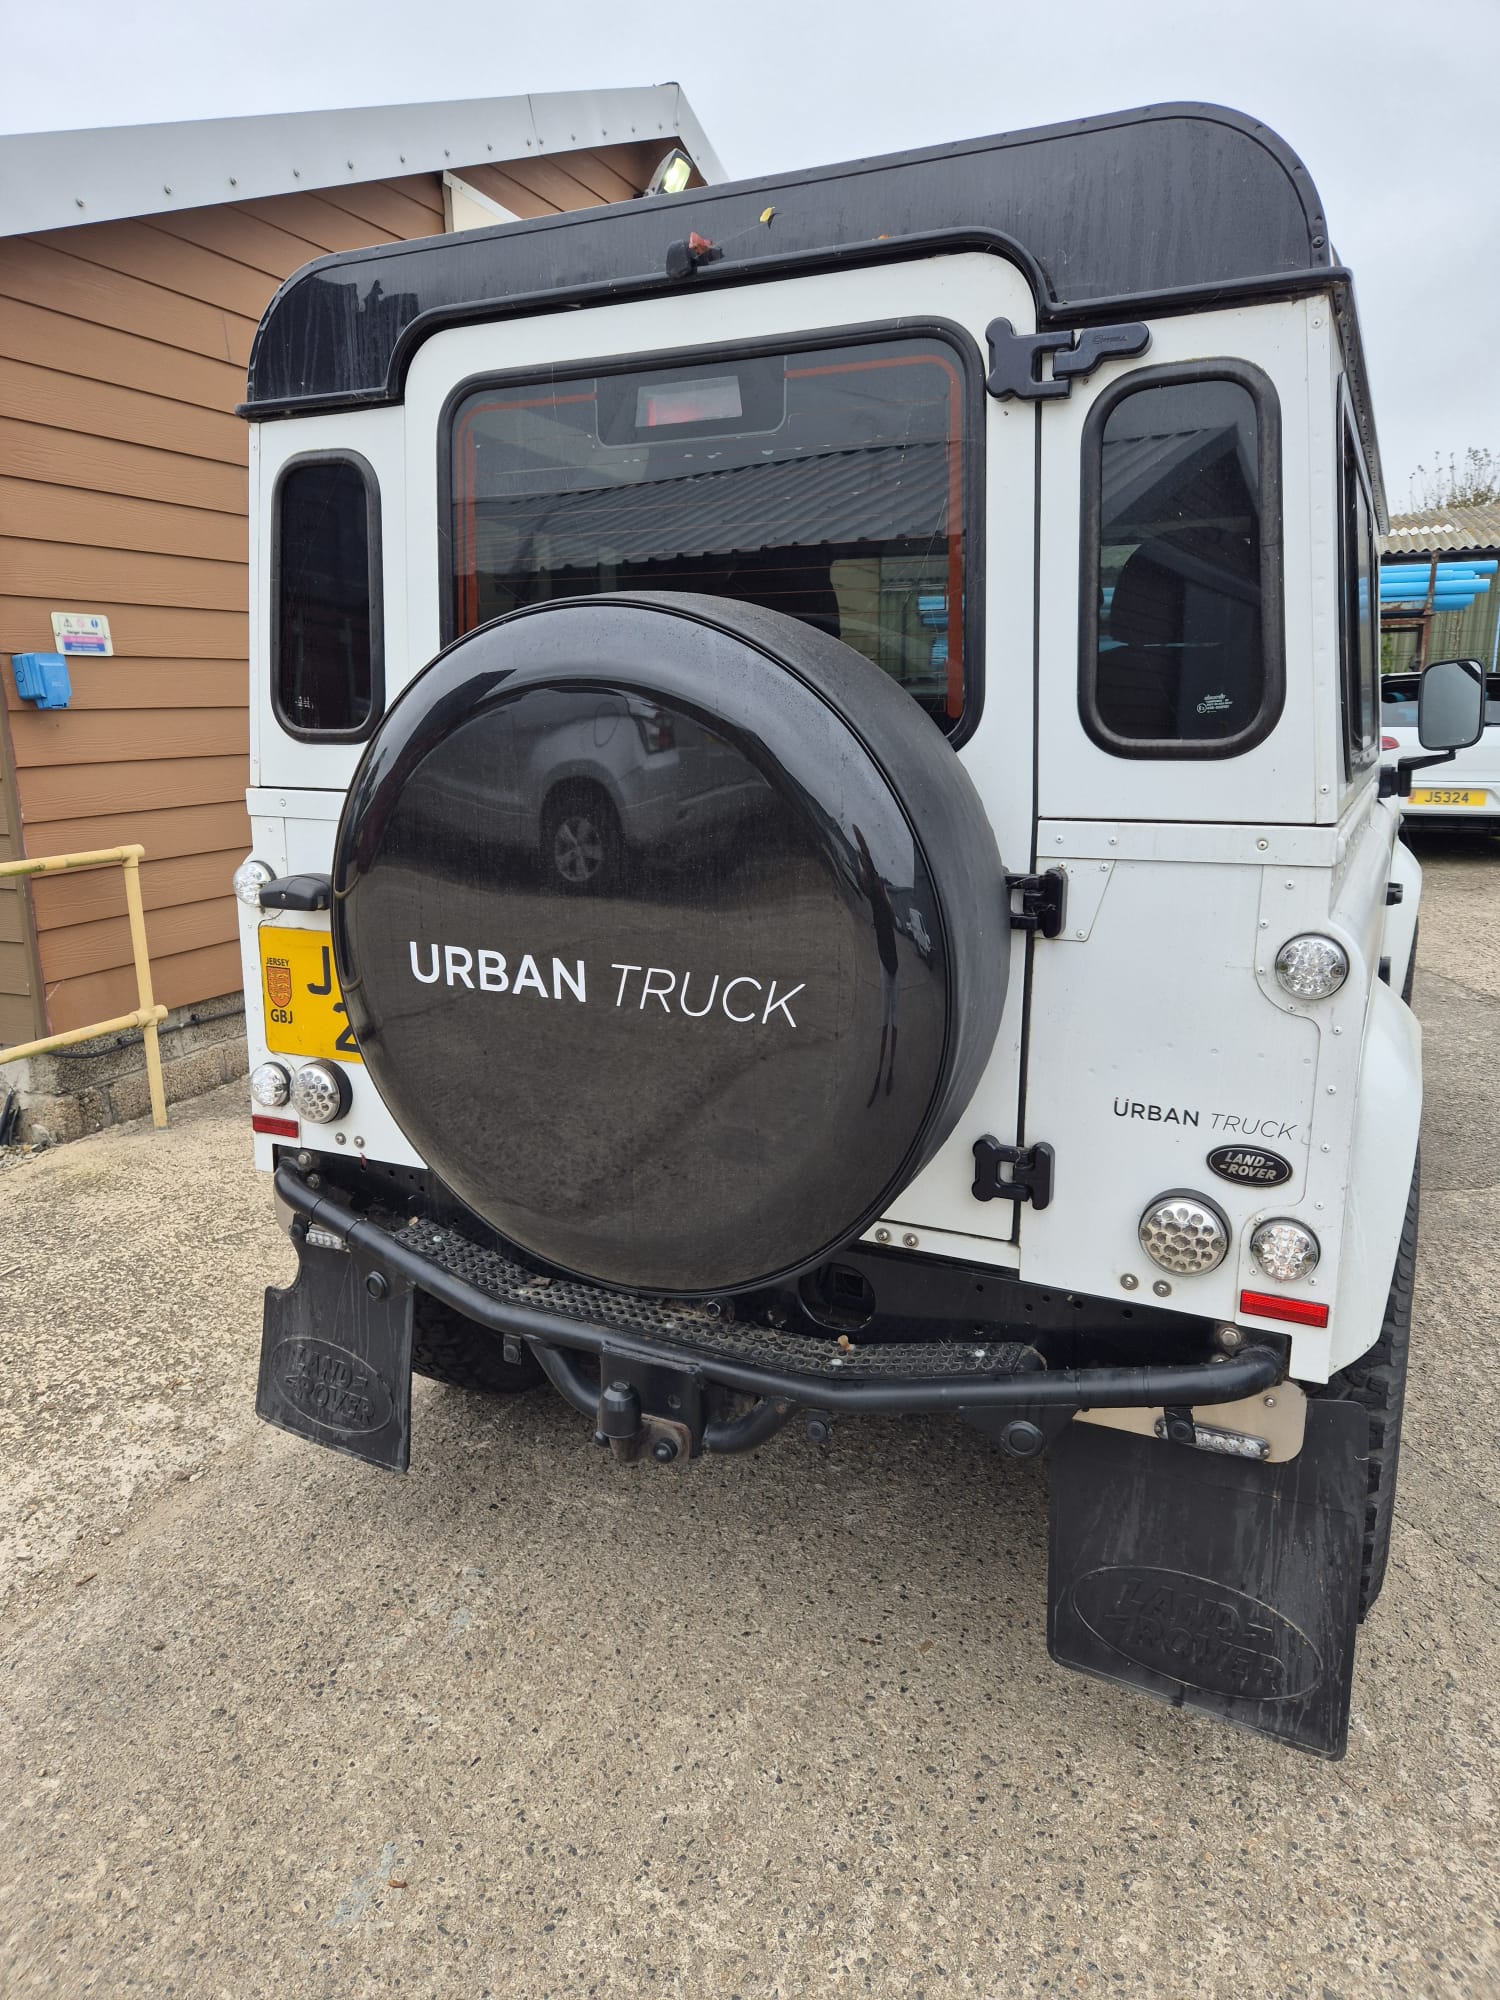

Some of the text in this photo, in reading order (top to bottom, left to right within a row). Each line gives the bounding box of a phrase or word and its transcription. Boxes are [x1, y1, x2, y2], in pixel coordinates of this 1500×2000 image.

[1424, 791, 1469, 803] J5324
[266, 957, 290, 967] JERSEY
[409, 941, 806, 1028] URBAN TRUCK
[270, 1008, 293, 1024] GBJ
[1211, 1112, 1298, 1141] TRUCK
